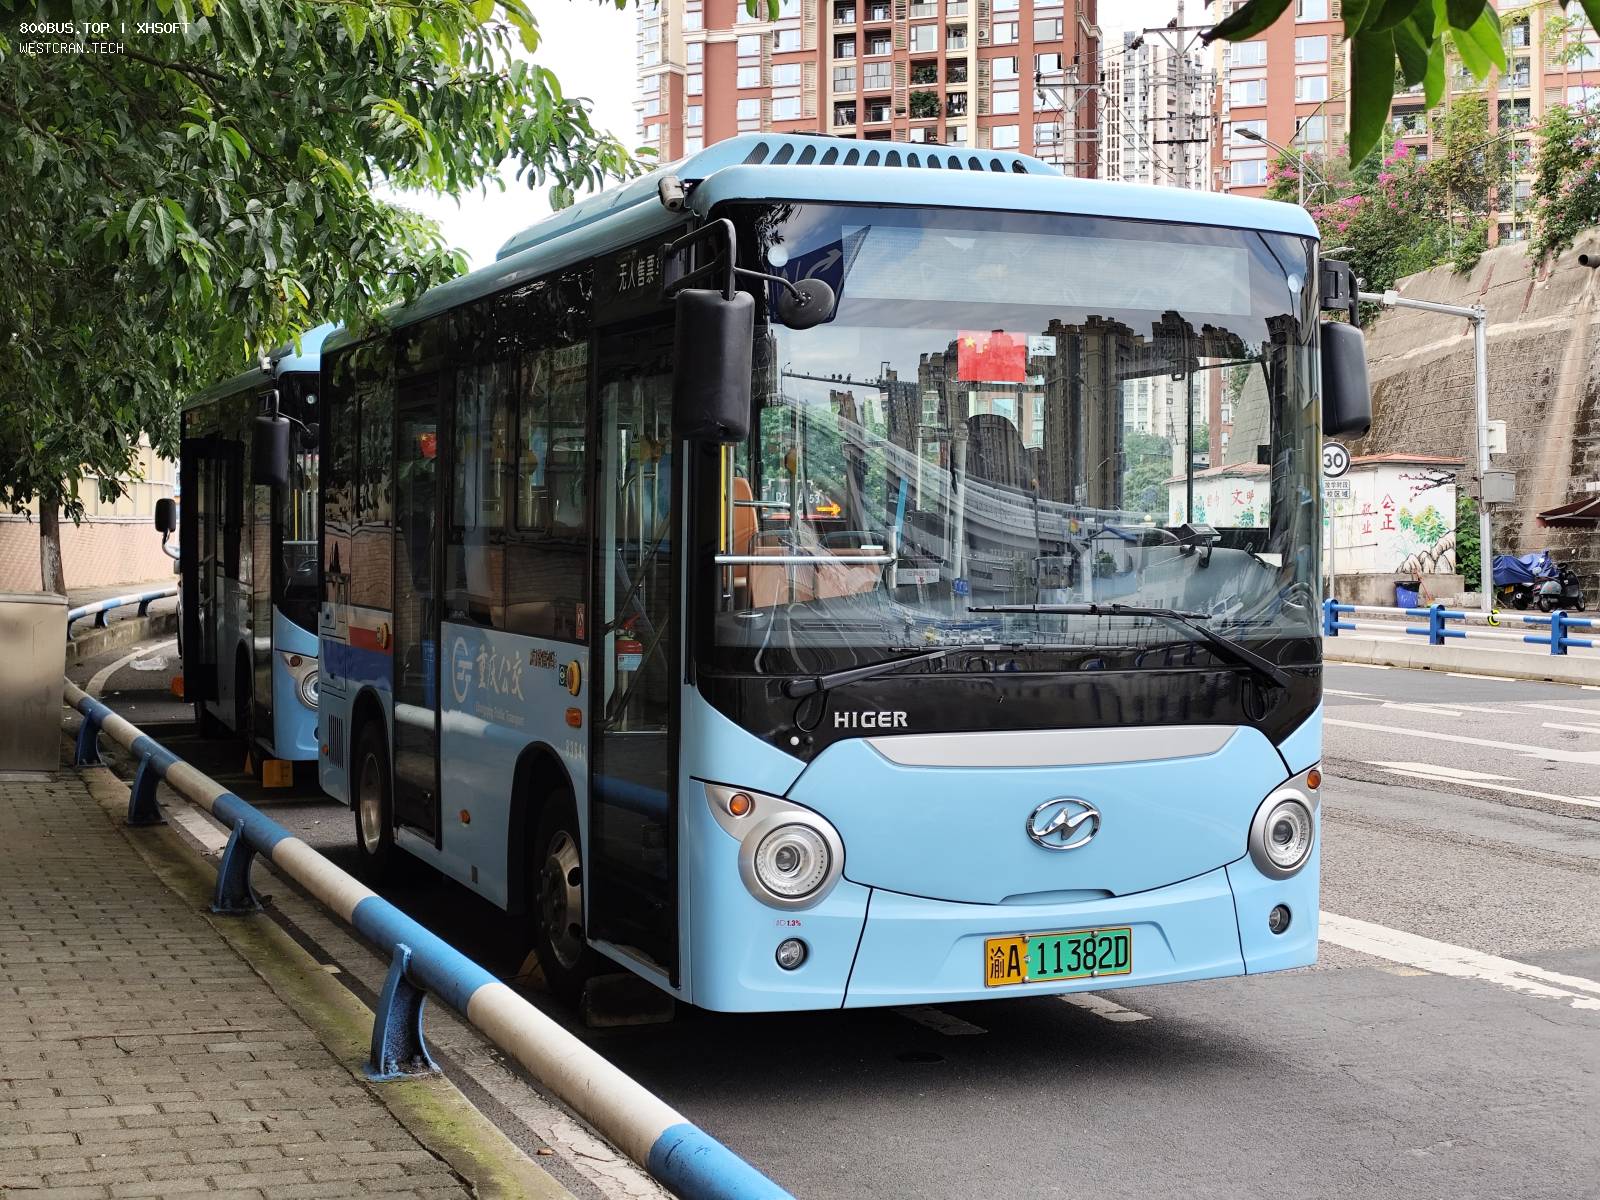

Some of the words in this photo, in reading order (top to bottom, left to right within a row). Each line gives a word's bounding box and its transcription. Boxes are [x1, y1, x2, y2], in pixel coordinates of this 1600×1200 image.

[618, 254, 660, 293] 无人售票
[1323, 452, 1344, 469] 30
[1380, 493, 1396, 531] 公正
[475, 643, 525, 702] 重庆公交
[834, 711, 908, 729] HIGER
[786, 919, 802, 927] 1.3%
[990, 944, 1021, 979] 渝A
[1037, 935, 1128, 975] 11382D
